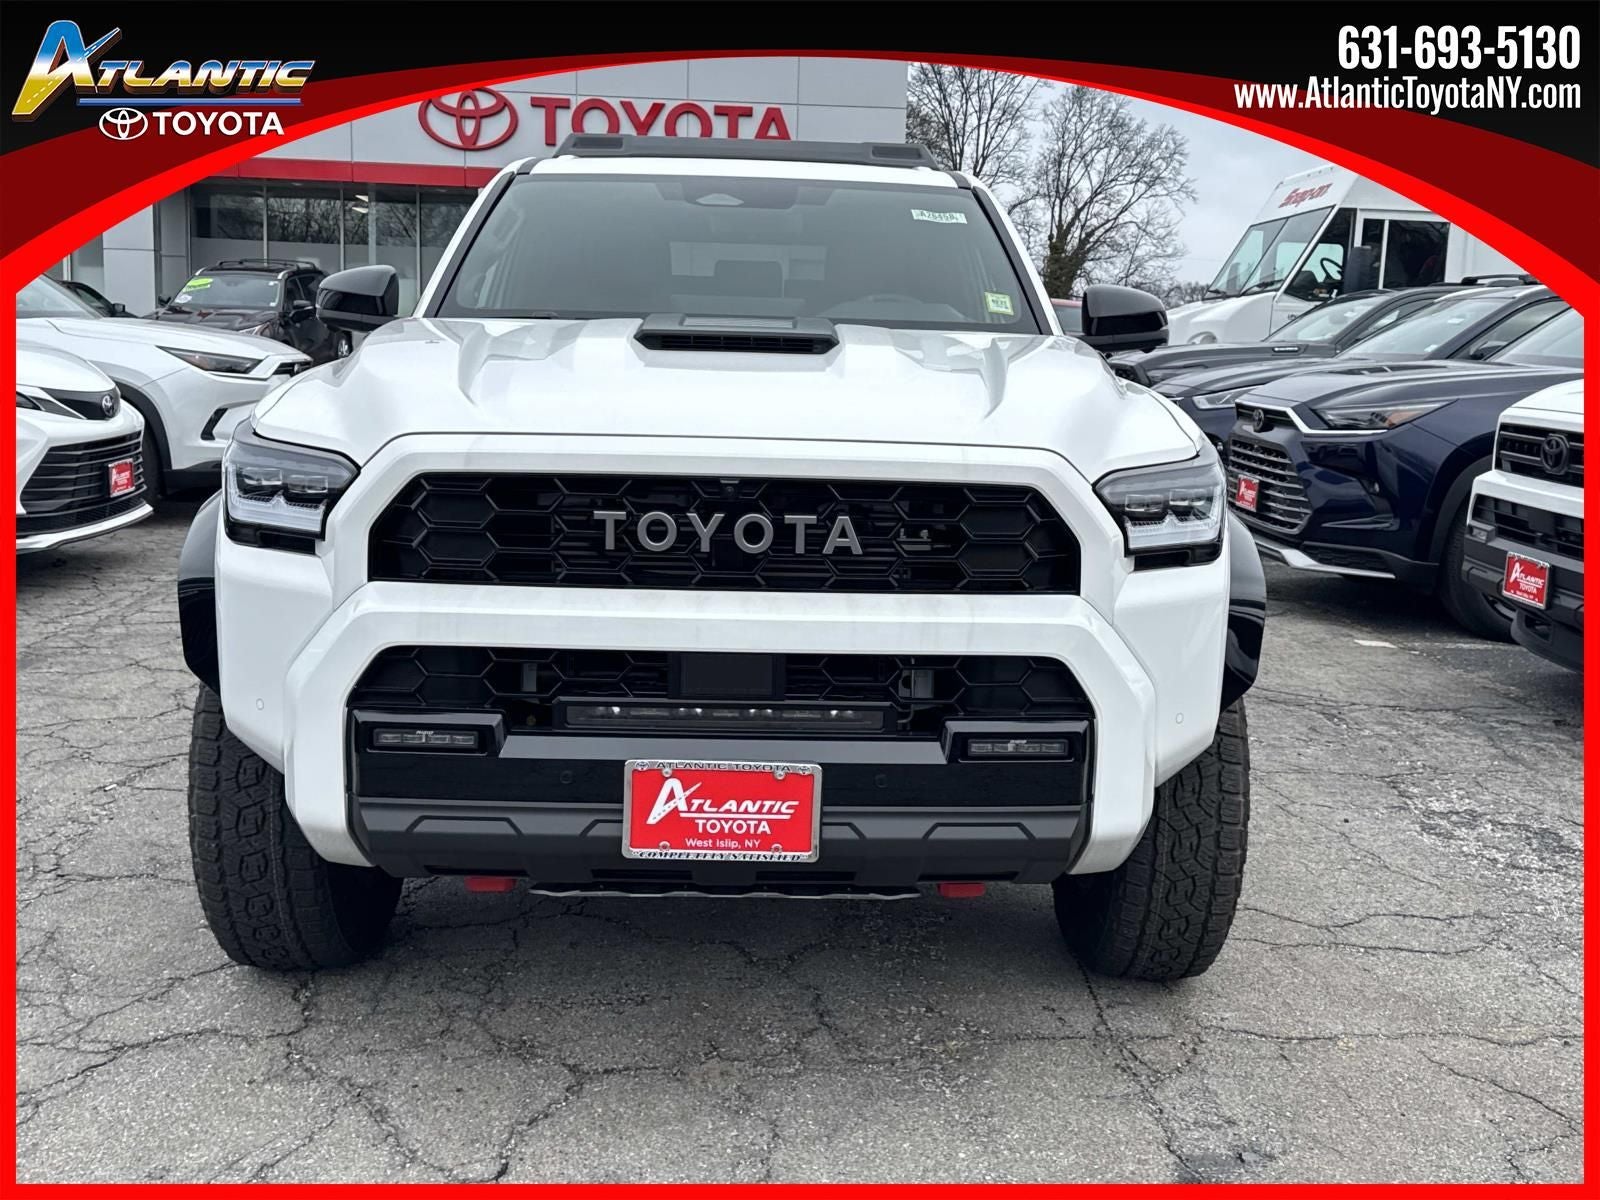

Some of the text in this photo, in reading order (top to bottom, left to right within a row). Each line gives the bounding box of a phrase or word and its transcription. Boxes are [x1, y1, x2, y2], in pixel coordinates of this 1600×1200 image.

[530, 96, 792, 146] TOYOTA
[593, 510, 863, 555] TOYOTA
[656, 761, 791, 772] ATLANTIC TOYOTA
[646, 777, 800, 825] ATLANTIC
[695, 819, 771, 835] TOYOTA
[685, 837, 761, 850] West Islip, NY
